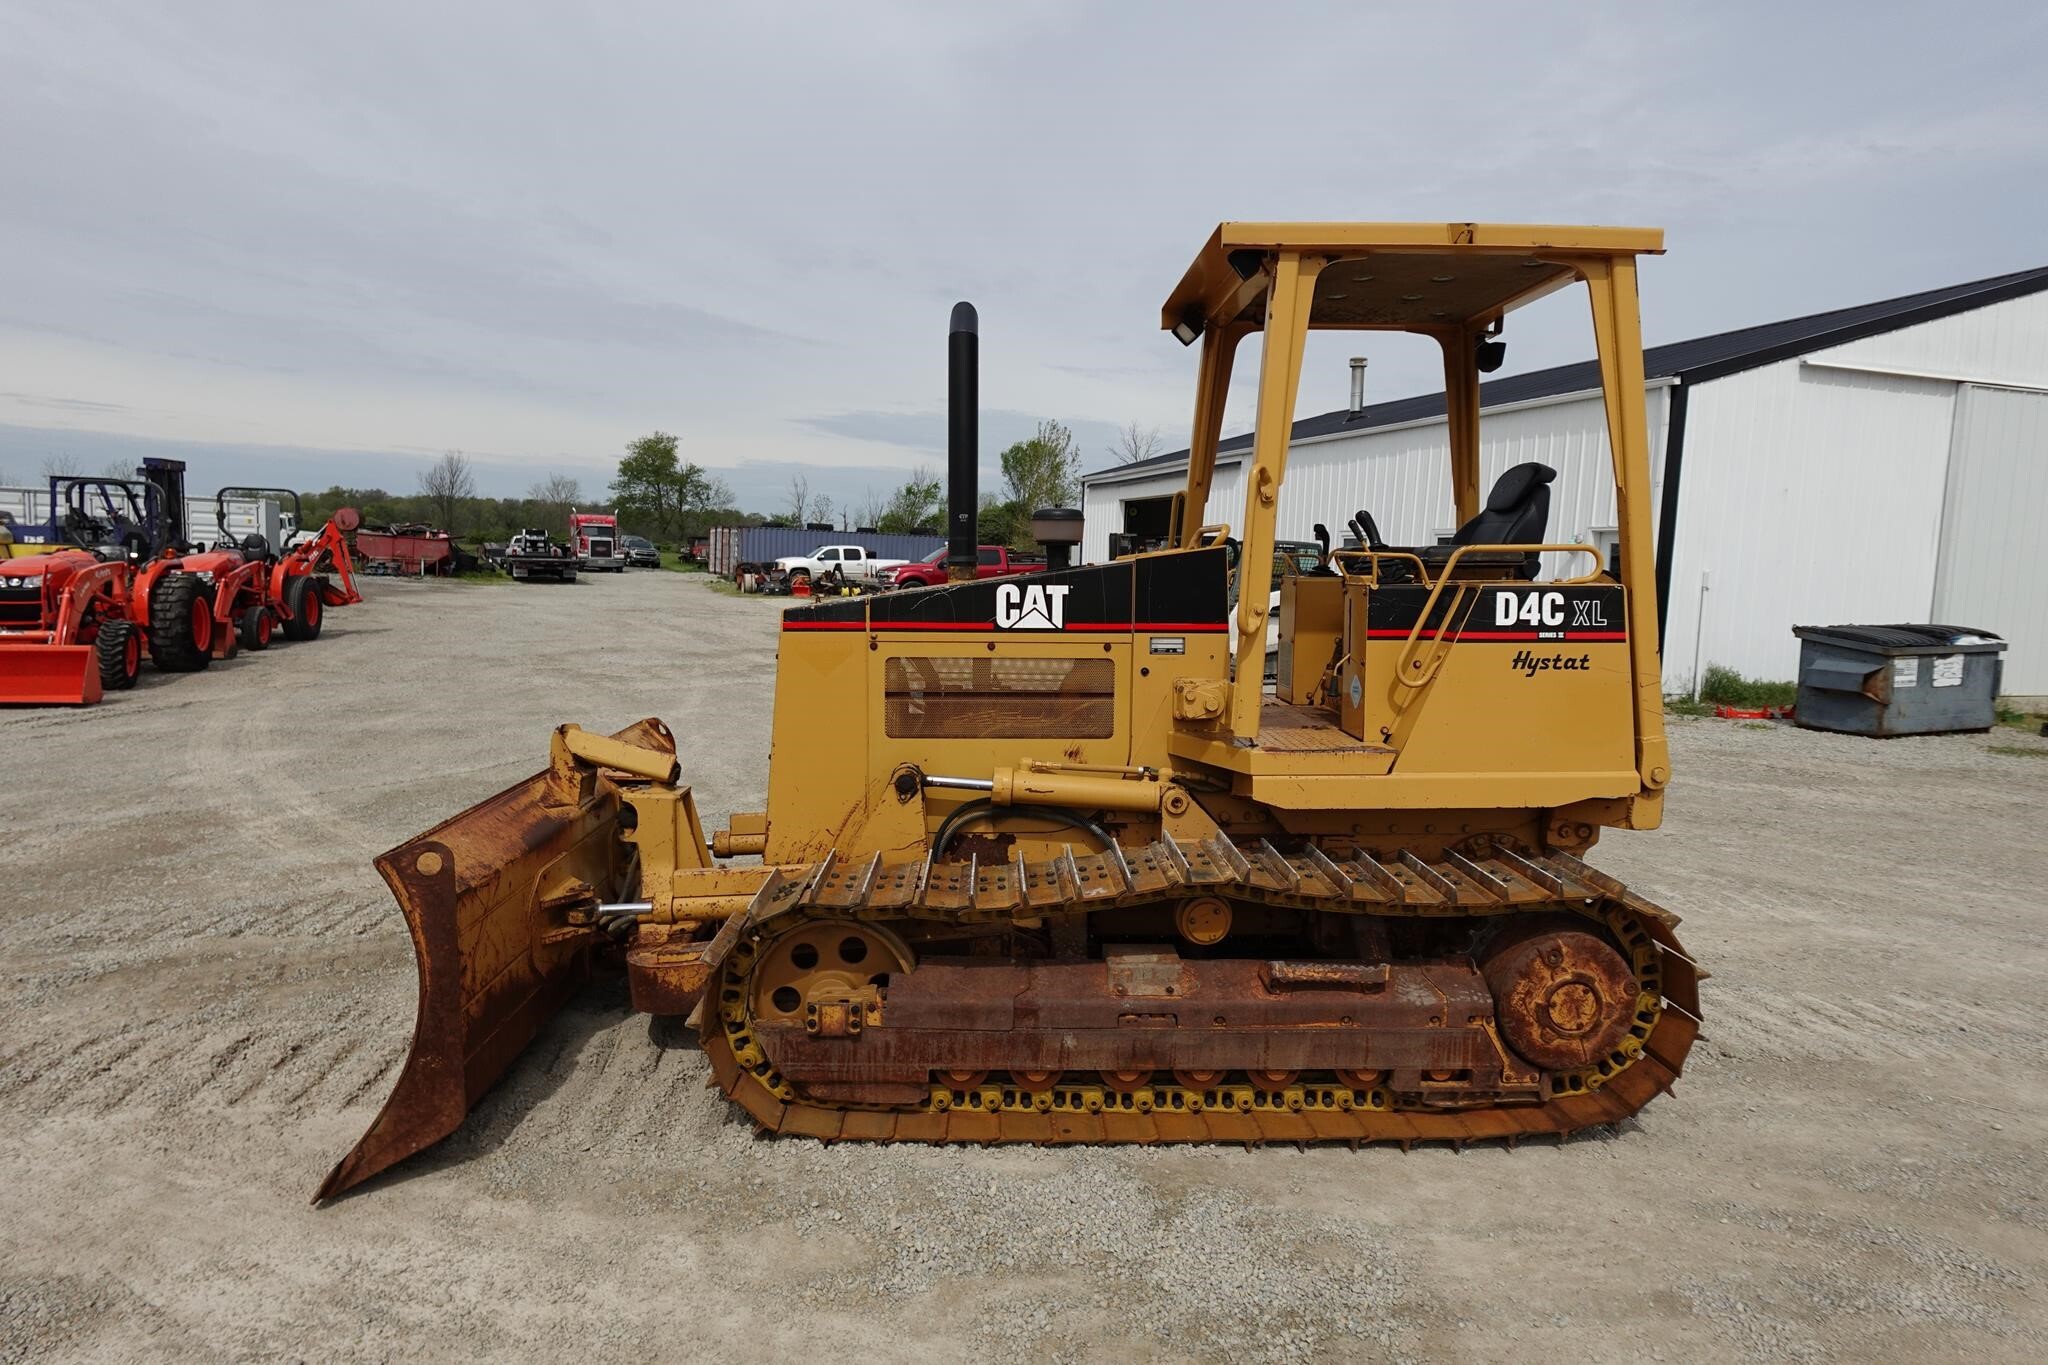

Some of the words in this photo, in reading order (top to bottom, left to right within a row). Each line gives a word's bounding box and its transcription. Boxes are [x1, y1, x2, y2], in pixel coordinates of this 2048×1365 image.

[996, 584, 1069, 629] CAT
[1495, 591, 1565, 626] D4C
[1572, 600, 1608, 626] XL
[1512, 651, 1590, 677] Hystat
